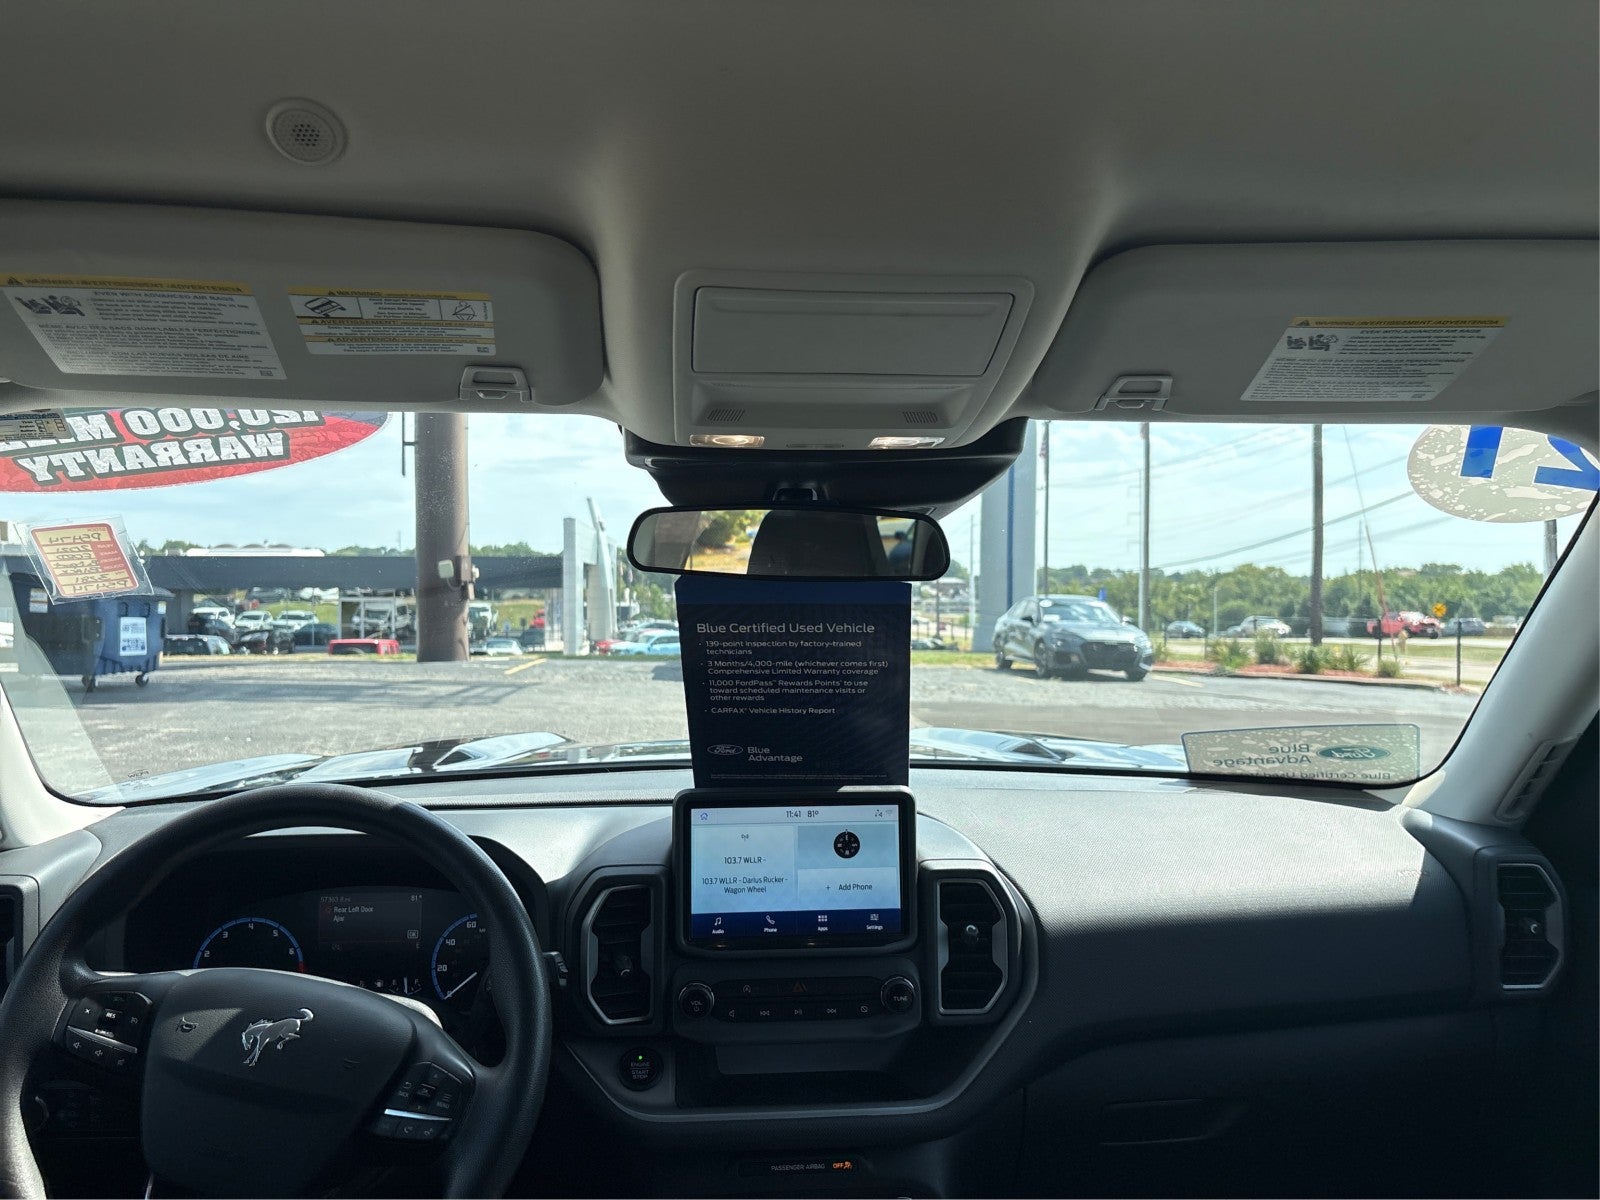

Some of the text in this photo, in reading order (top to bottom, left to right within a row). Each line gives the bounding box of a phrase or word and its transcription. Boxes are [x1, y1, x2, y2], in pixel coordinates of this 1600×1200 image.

[696, 622, 875, 634] Blue Certified Used Vehicle
[705, 640, 862, 650] 139-point inspection by factory-trained
[714, 660, 793, 669] Months/4,000-mile
[794, 660, 835, 669] (whichever
[836, 661, 867, 669] comes
[868, 660, 889, 669] first)
[708, 668, 879, 677] Comprehensive Limited Warranty coverage
[708, 679, 734, 687] 11,000
[778, 679, 813, 687] Rewards
[709, 687, 739, 695] toward
[738, 687, 781, 695] scheduled
[781, 687, 834, 695] maintenance
[834, 687, 856, 695] visits
[709, 694, 765, 702] other rewards
[748, 706, 778, 715] Vehicle
[779, 706, 807, 716] History
[808, 706, 836, 716] Report
[747, 745, 771, 754] Blue
[748, 754, 804, 765] Advantage
[785, 810, 802, 818] 11:41
[724, 857, 743, 865] 103.7
[743, 856, 763, 865] WLLR
[702, 877, 719, 885] 103.7
[719, 876, 738, 885] WLLR
[742, 876, 763, 884] Darius
[763, 876, 785, 884] Rucker
[723, 885, 768, 895] Wagon Wheel
[838, 883, 873, 891] Add Phone
[248, 922, 255, 930] 4
[222, 930, 229, 939] 3
[272, 929, 279, 937] 5
[445, 938, 456, 946] 40
[203, 950, 210, 958] 2
[437, 964, 448, 972] 20
[805, 1162, 826, 1170] AIRBAG
[832, 1162, 844, 1170] OFF
